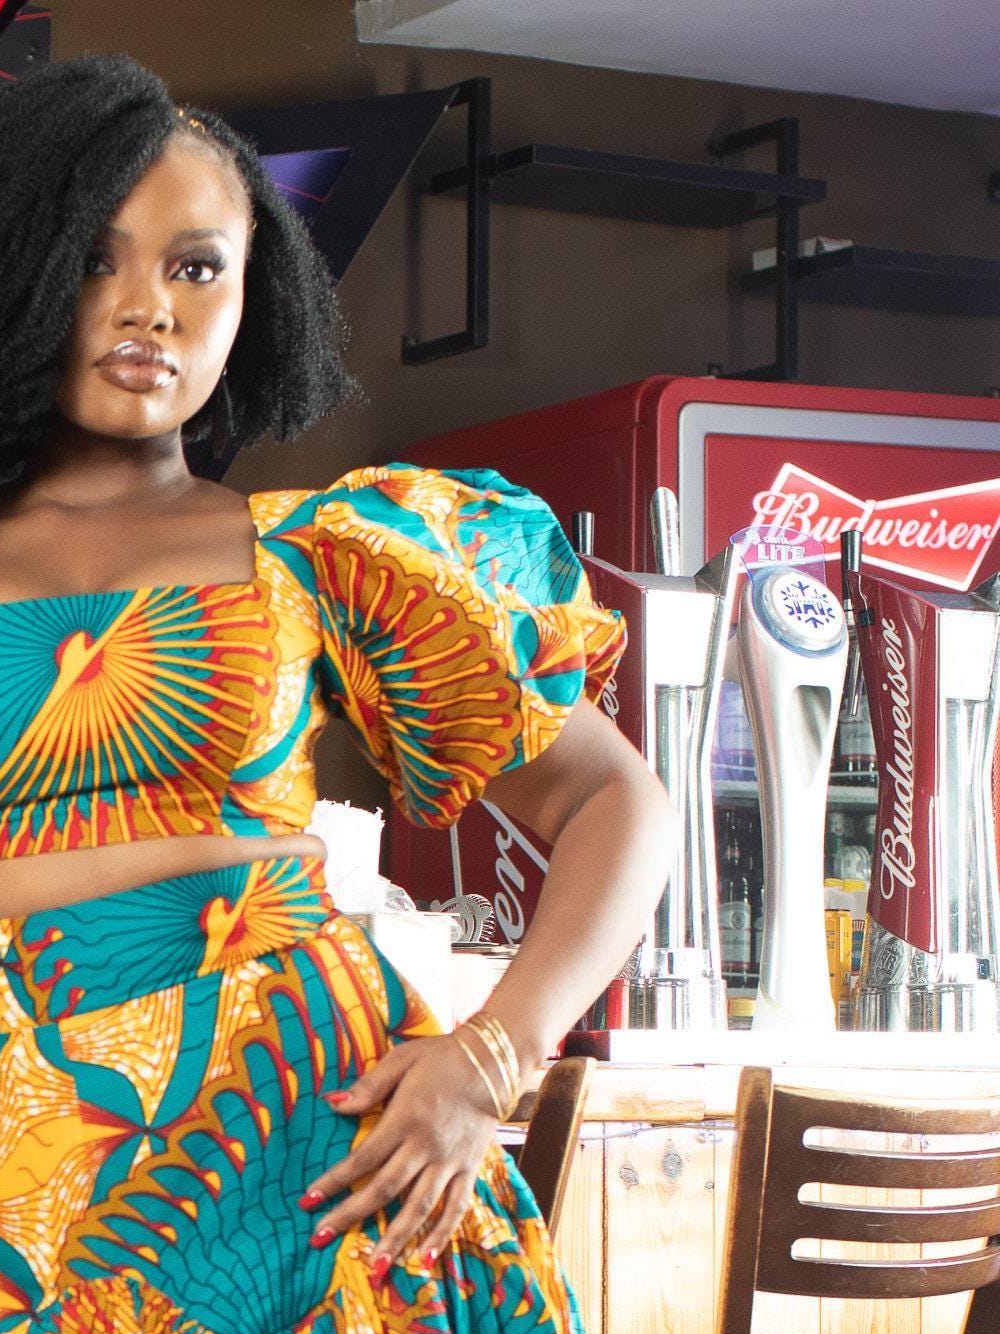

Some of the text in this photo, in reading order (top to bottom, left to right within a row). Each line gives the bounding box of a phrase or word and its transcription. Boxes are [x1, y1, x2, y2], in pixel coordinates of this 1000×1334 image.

[753, 490, 993, 551] Budweiser
[757, 543, 807, 563] LITE
[880, 617, 916, 900] Budweiser
